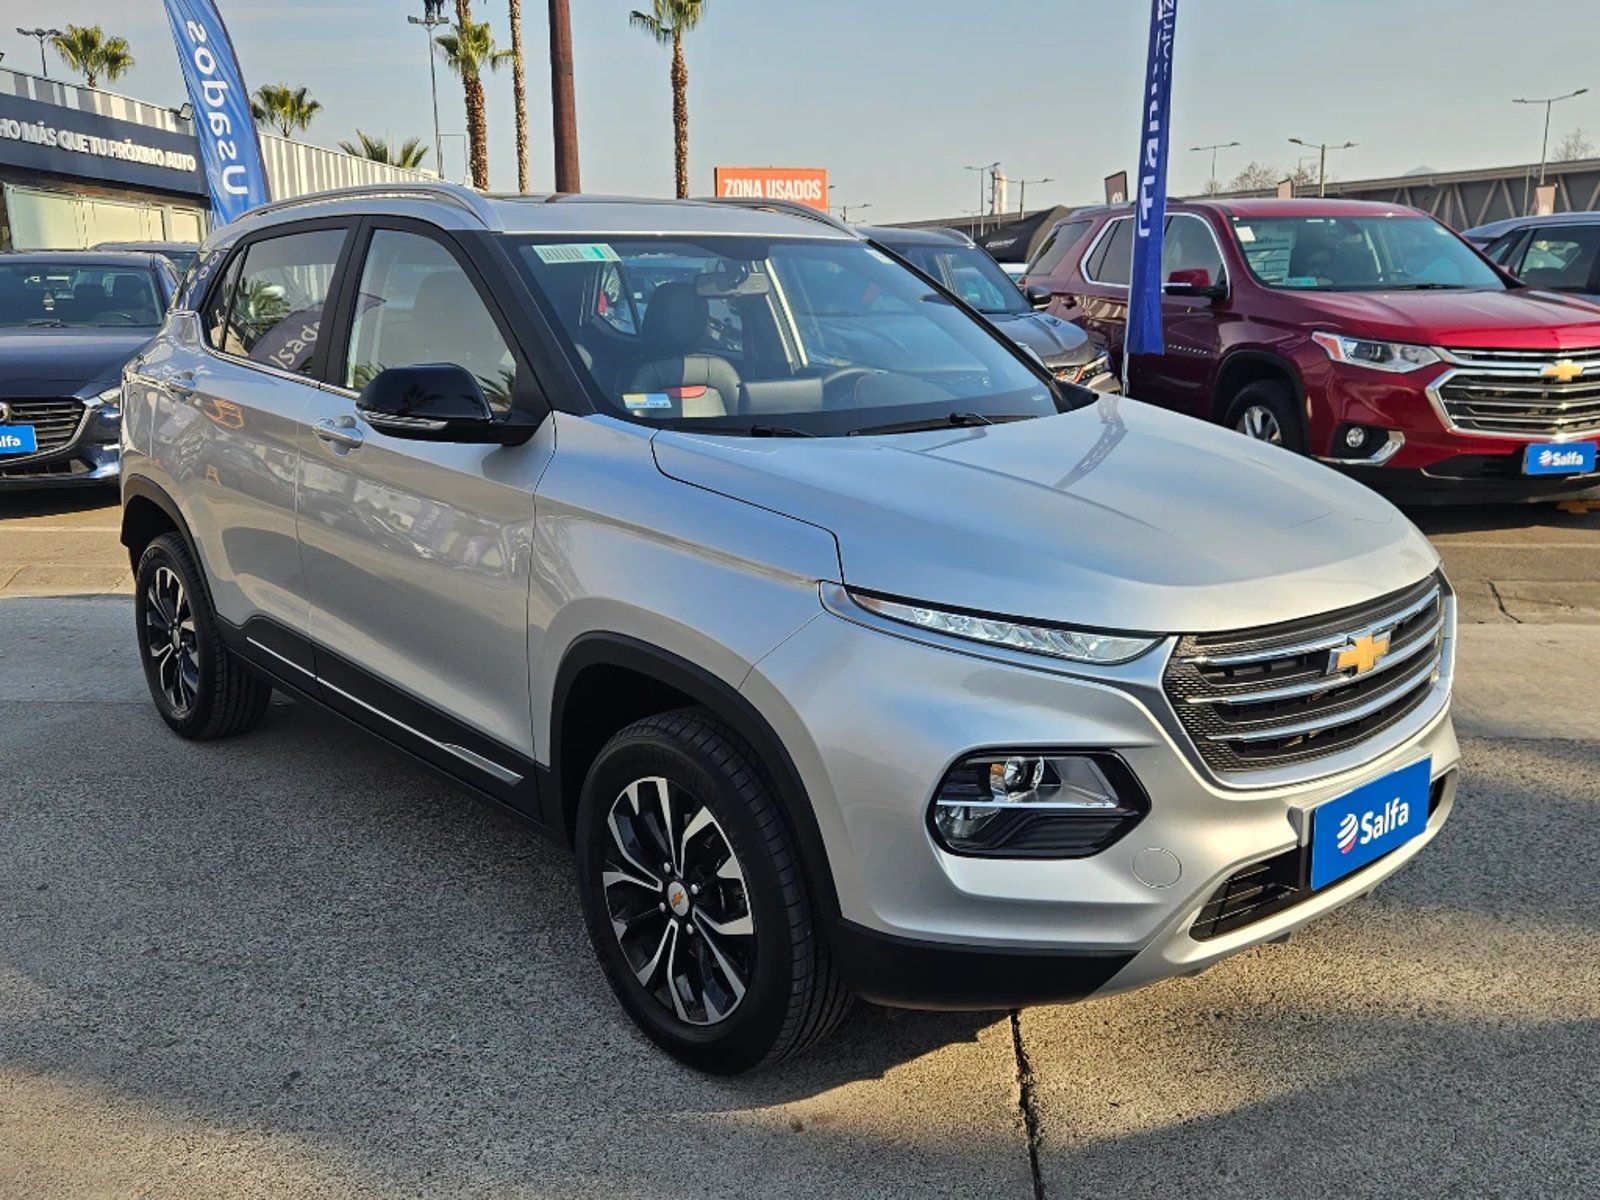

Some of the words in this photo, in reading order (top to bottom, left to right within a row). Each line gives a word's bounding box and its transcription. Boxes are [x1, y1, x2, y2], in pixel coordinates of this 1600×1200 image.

[20, 121, 57, 147] MÁS
[57, 129, 90, 154] QUE
[88, 136, 107, 156] TU
[107, 138, 165, 166] PRÓXIMO
[165, 151, 196, 172] AUTO
[724, 179, 763, 198] ZONA
[766, 179, 822, 199] USADOS
[1552, 451, 1584, 466] Salfa
[1360, 797, 1409, 845] Salfa
